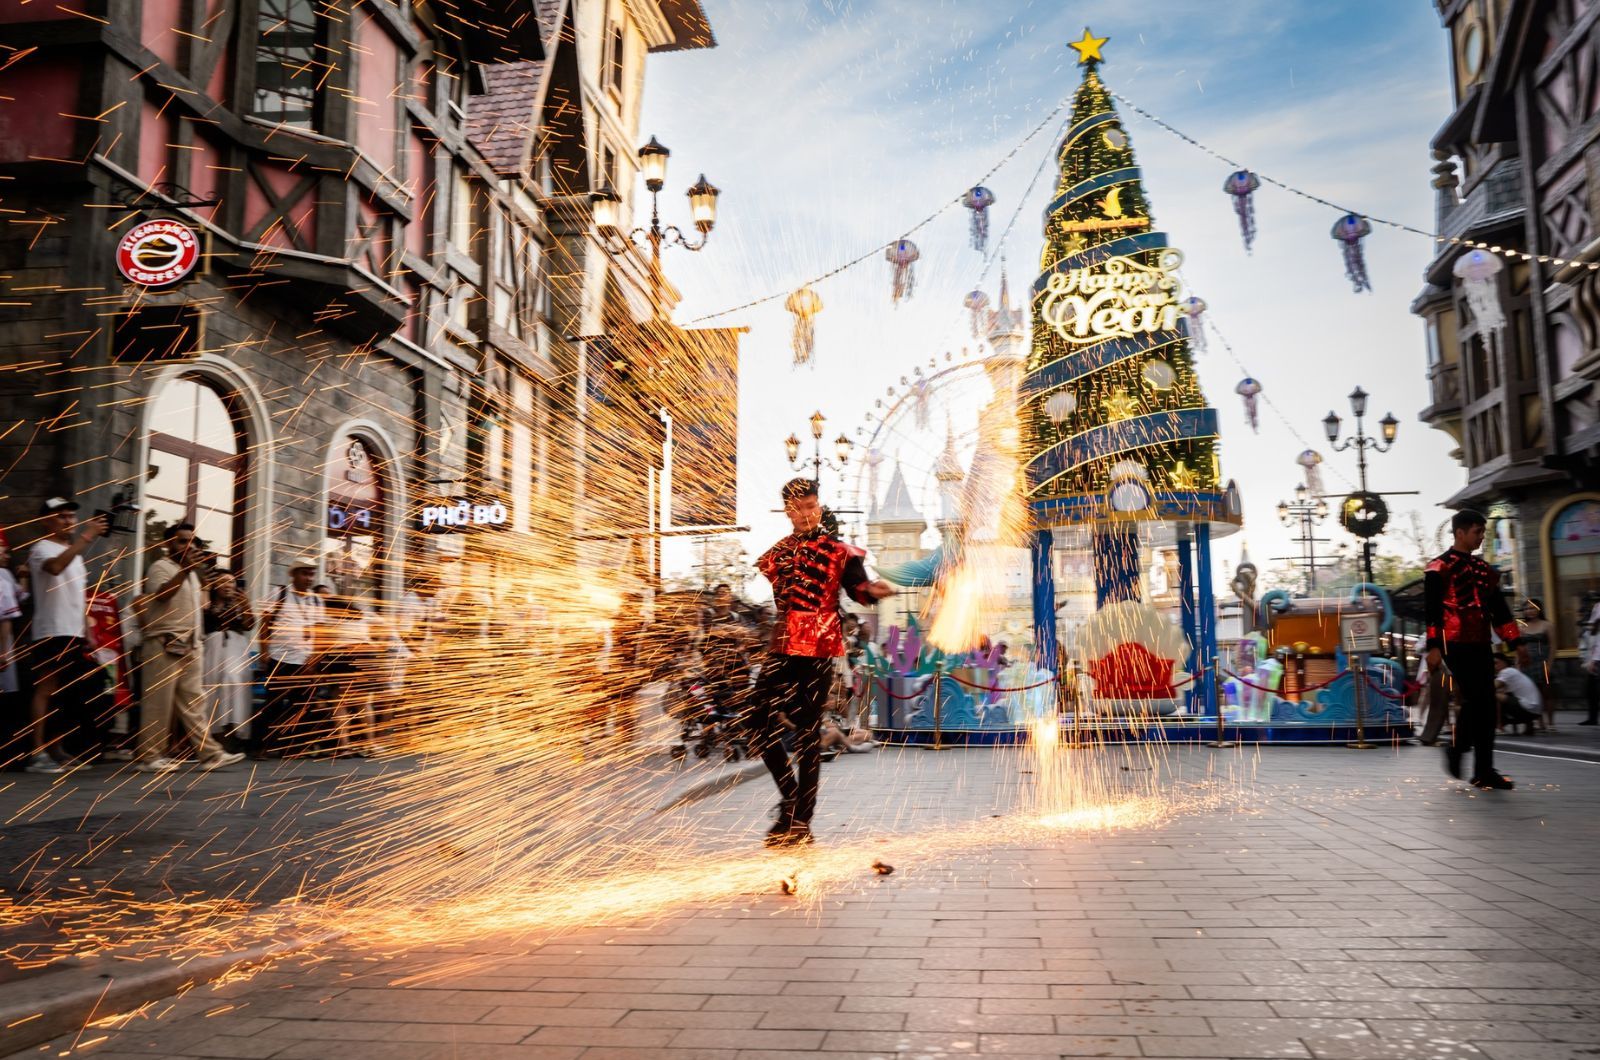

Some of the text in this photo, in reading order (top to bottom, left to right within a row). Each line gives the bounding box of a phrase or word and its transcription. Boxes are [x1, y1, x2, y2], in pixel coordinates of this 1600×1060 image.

[122, 223, 194, 251] HIGHLANDS
[128, 265, 184, 281] COFFEE
[1046, 258, 1160, 296] Happy
[1042, 289, 1183, 343] Year
[473, 500, 507, 524] BÒ
